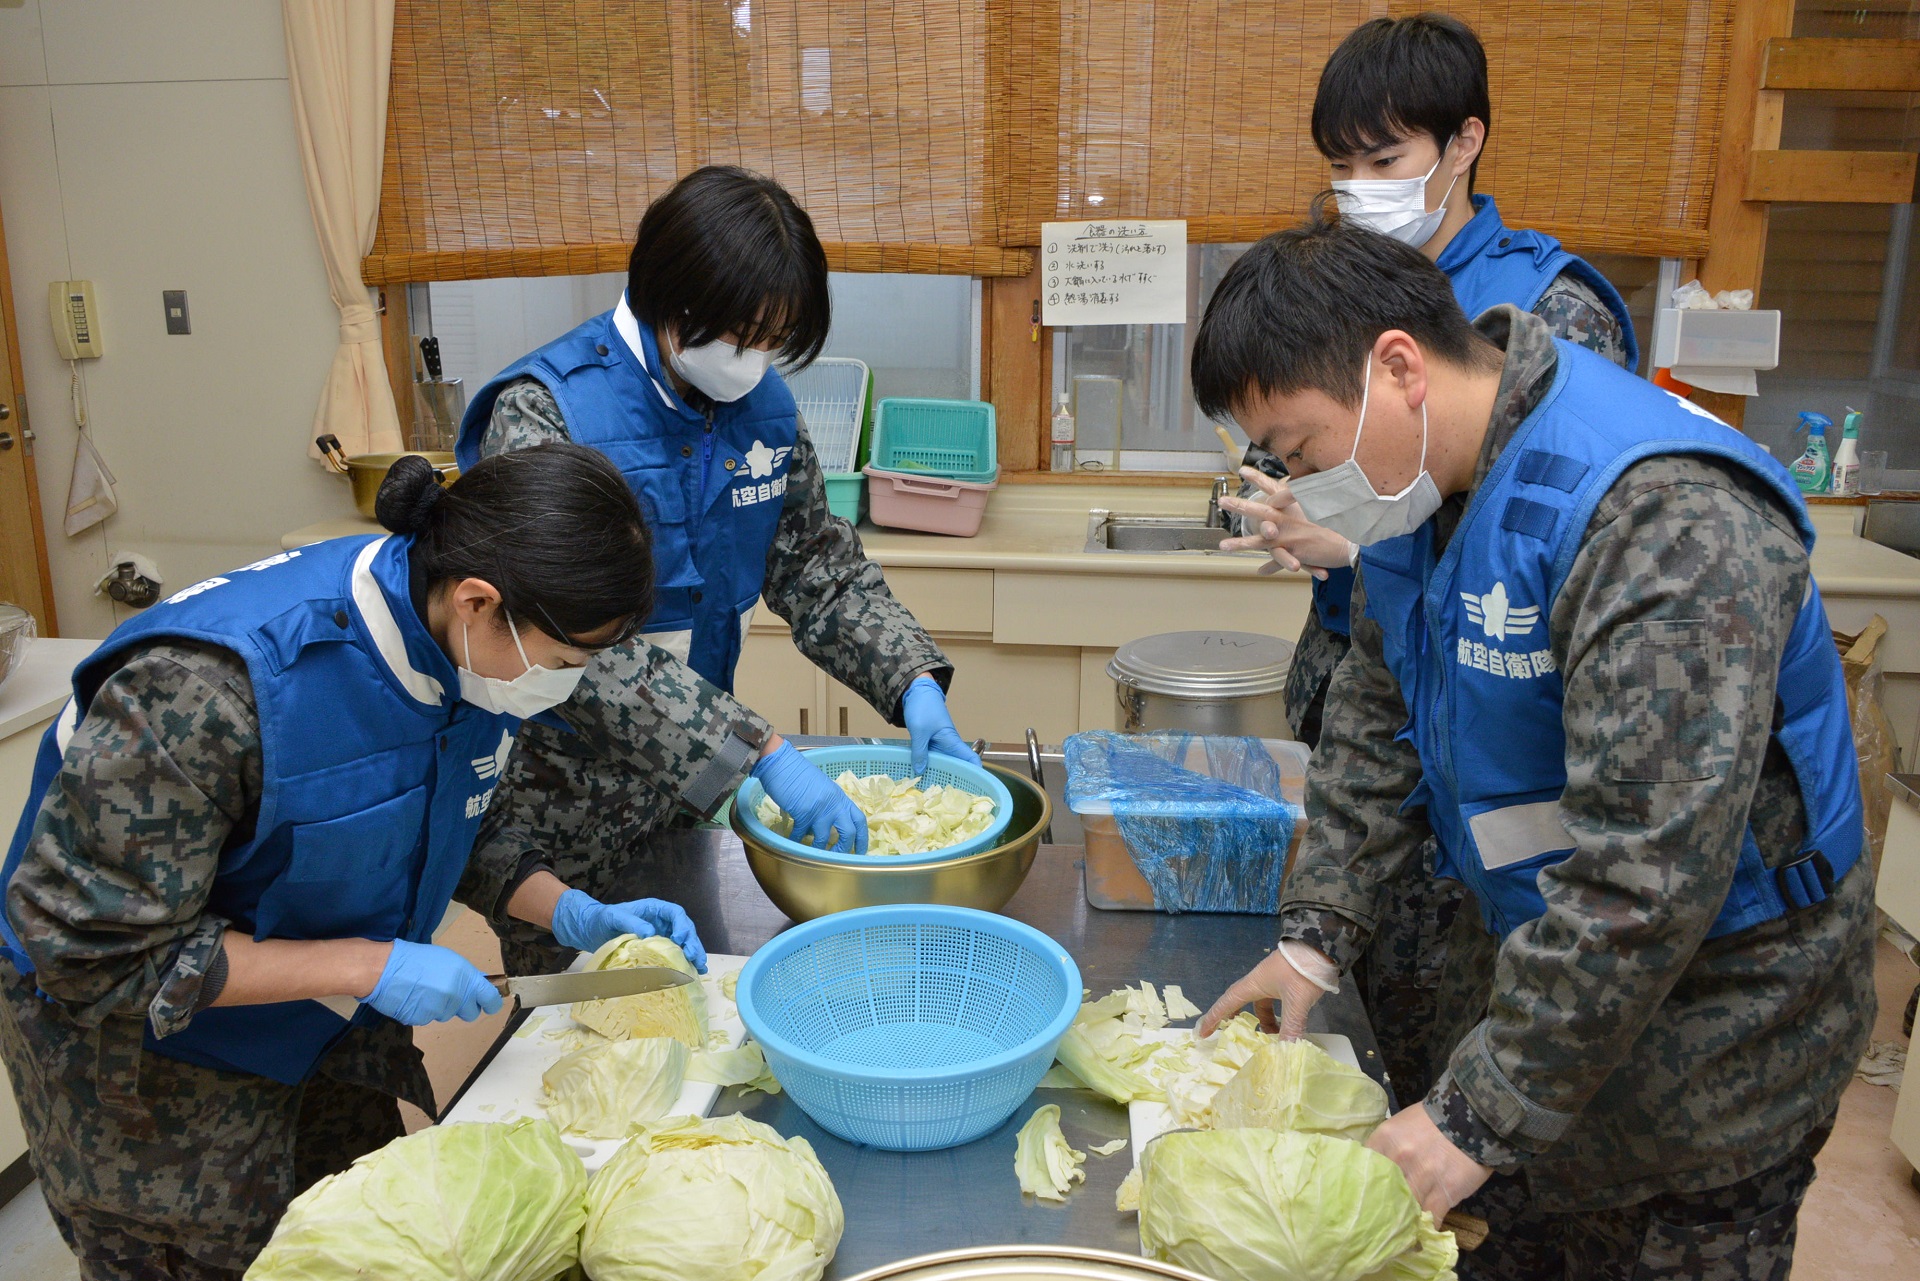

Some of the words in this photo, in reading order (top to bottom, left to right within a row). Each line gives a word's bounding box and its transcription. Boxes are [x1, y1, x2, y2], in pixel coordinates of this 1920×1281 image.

[1457, 636, 1557, 679] 航空自衛隊
[465, 785, 497, 819] 航空
